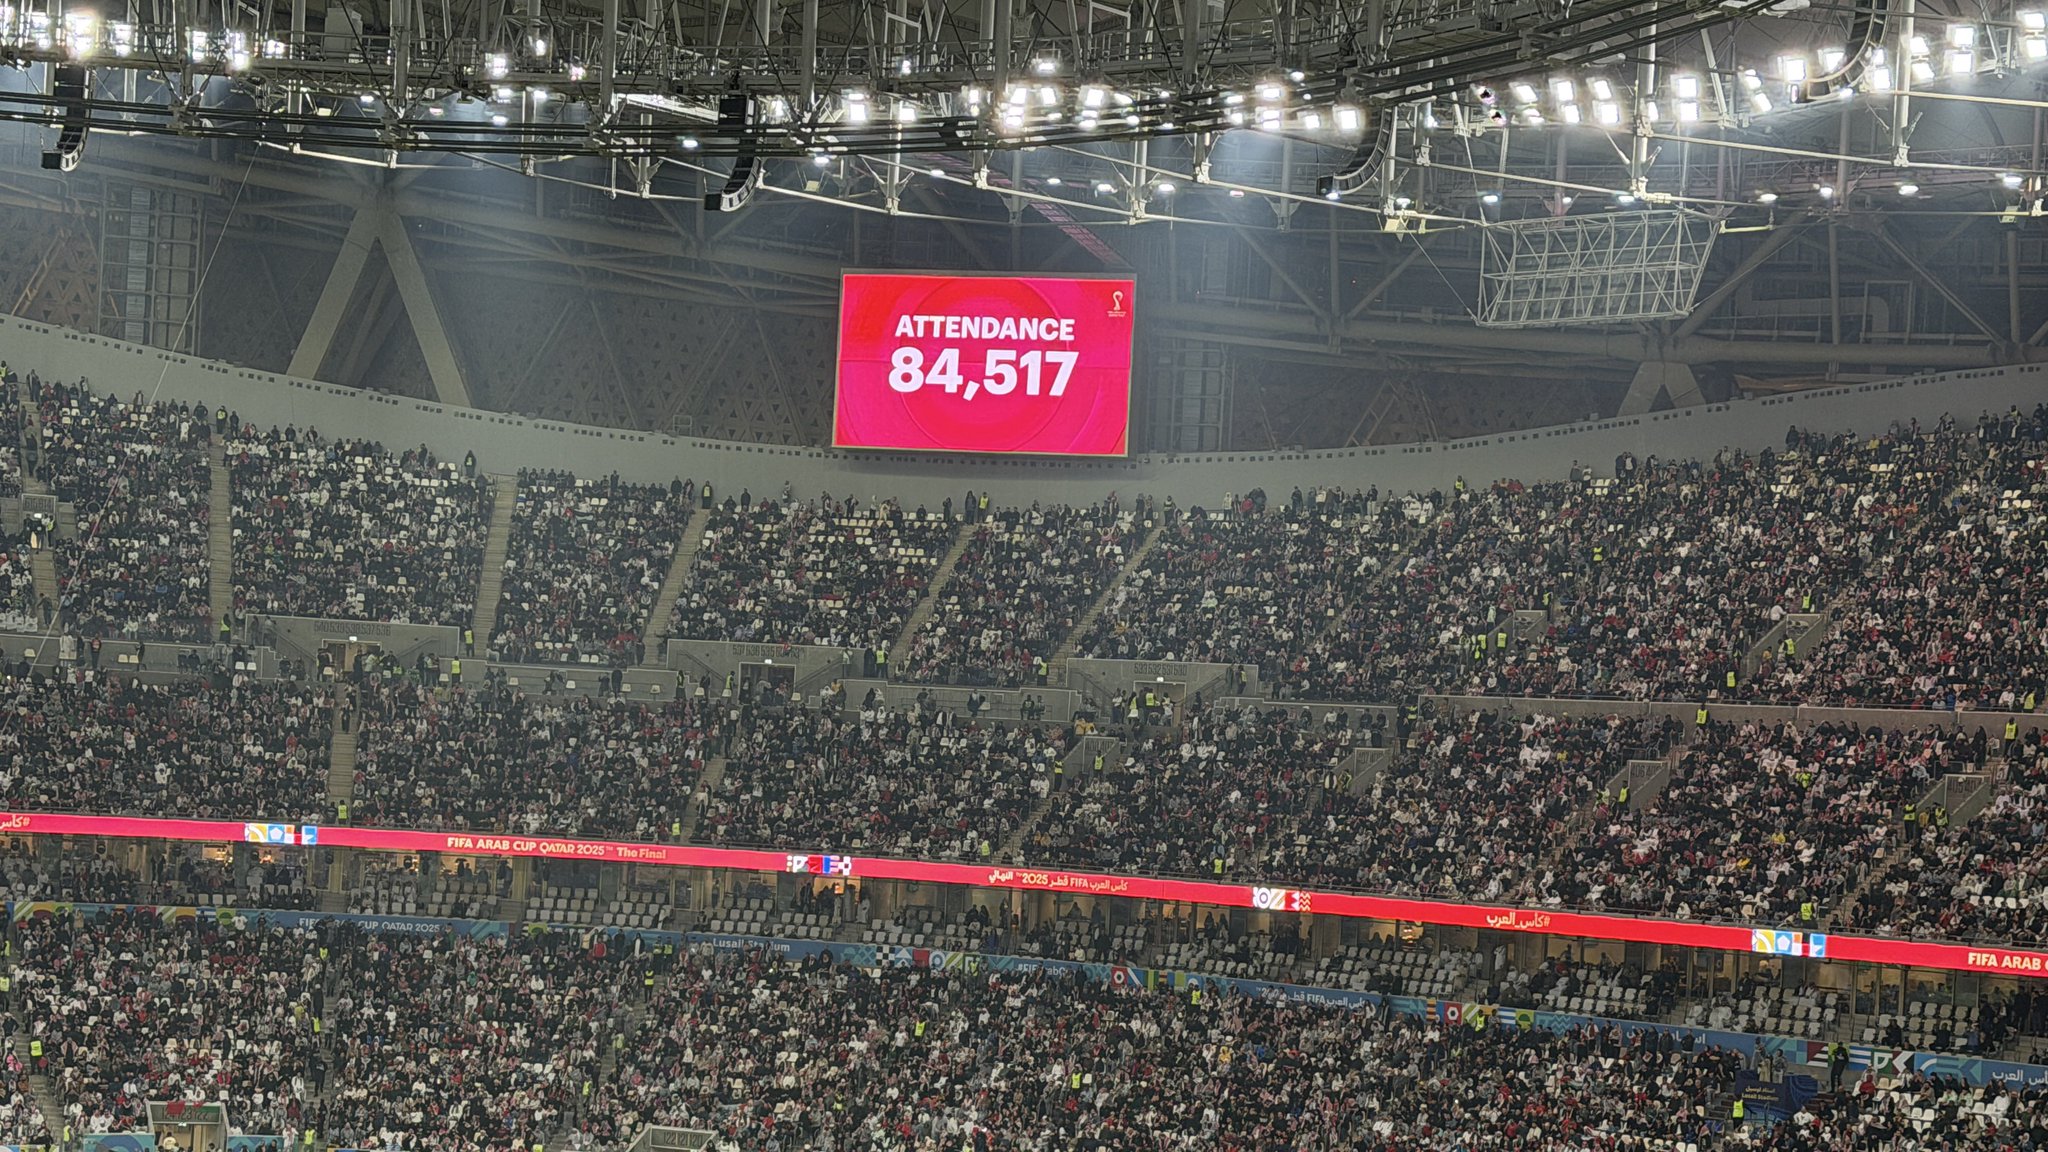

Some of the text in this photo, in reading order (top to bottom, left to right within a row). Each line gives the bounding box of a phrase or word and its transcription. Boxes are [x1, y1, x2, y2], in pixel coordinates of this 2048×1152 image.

[895, 314, 1076, 341] ATTENDANCE
[888, 346, 1079, 401] 84,517
[447, 837, 473, 848] FIFA
[476, 838, 510, 851] ARAB
[513, 840, 537, 852] CUP
[540, 841, 575, 854] QATAR
[617, 847, 638, 858] The
[639, 848, 666, 859] Final
[1049, 874, 1069, 888] قطر
[1070, 877, 1089, 889] FIFA
[1089, 878, 1110, 892] العرب
[1110, 879, 1128, 892] كأس
[382, 921, 413, 931] QATAR
[415, 923, 441, 933] 2025
[713, 937, 744, 949] Lusail
[1968, 951, 1998, 967] FIFA
[2000, 954, 2041, 971] ARAB
[1306, 993, 1326, 1005] FIFA
[1992, 1069, 2024, 1083] العرب
